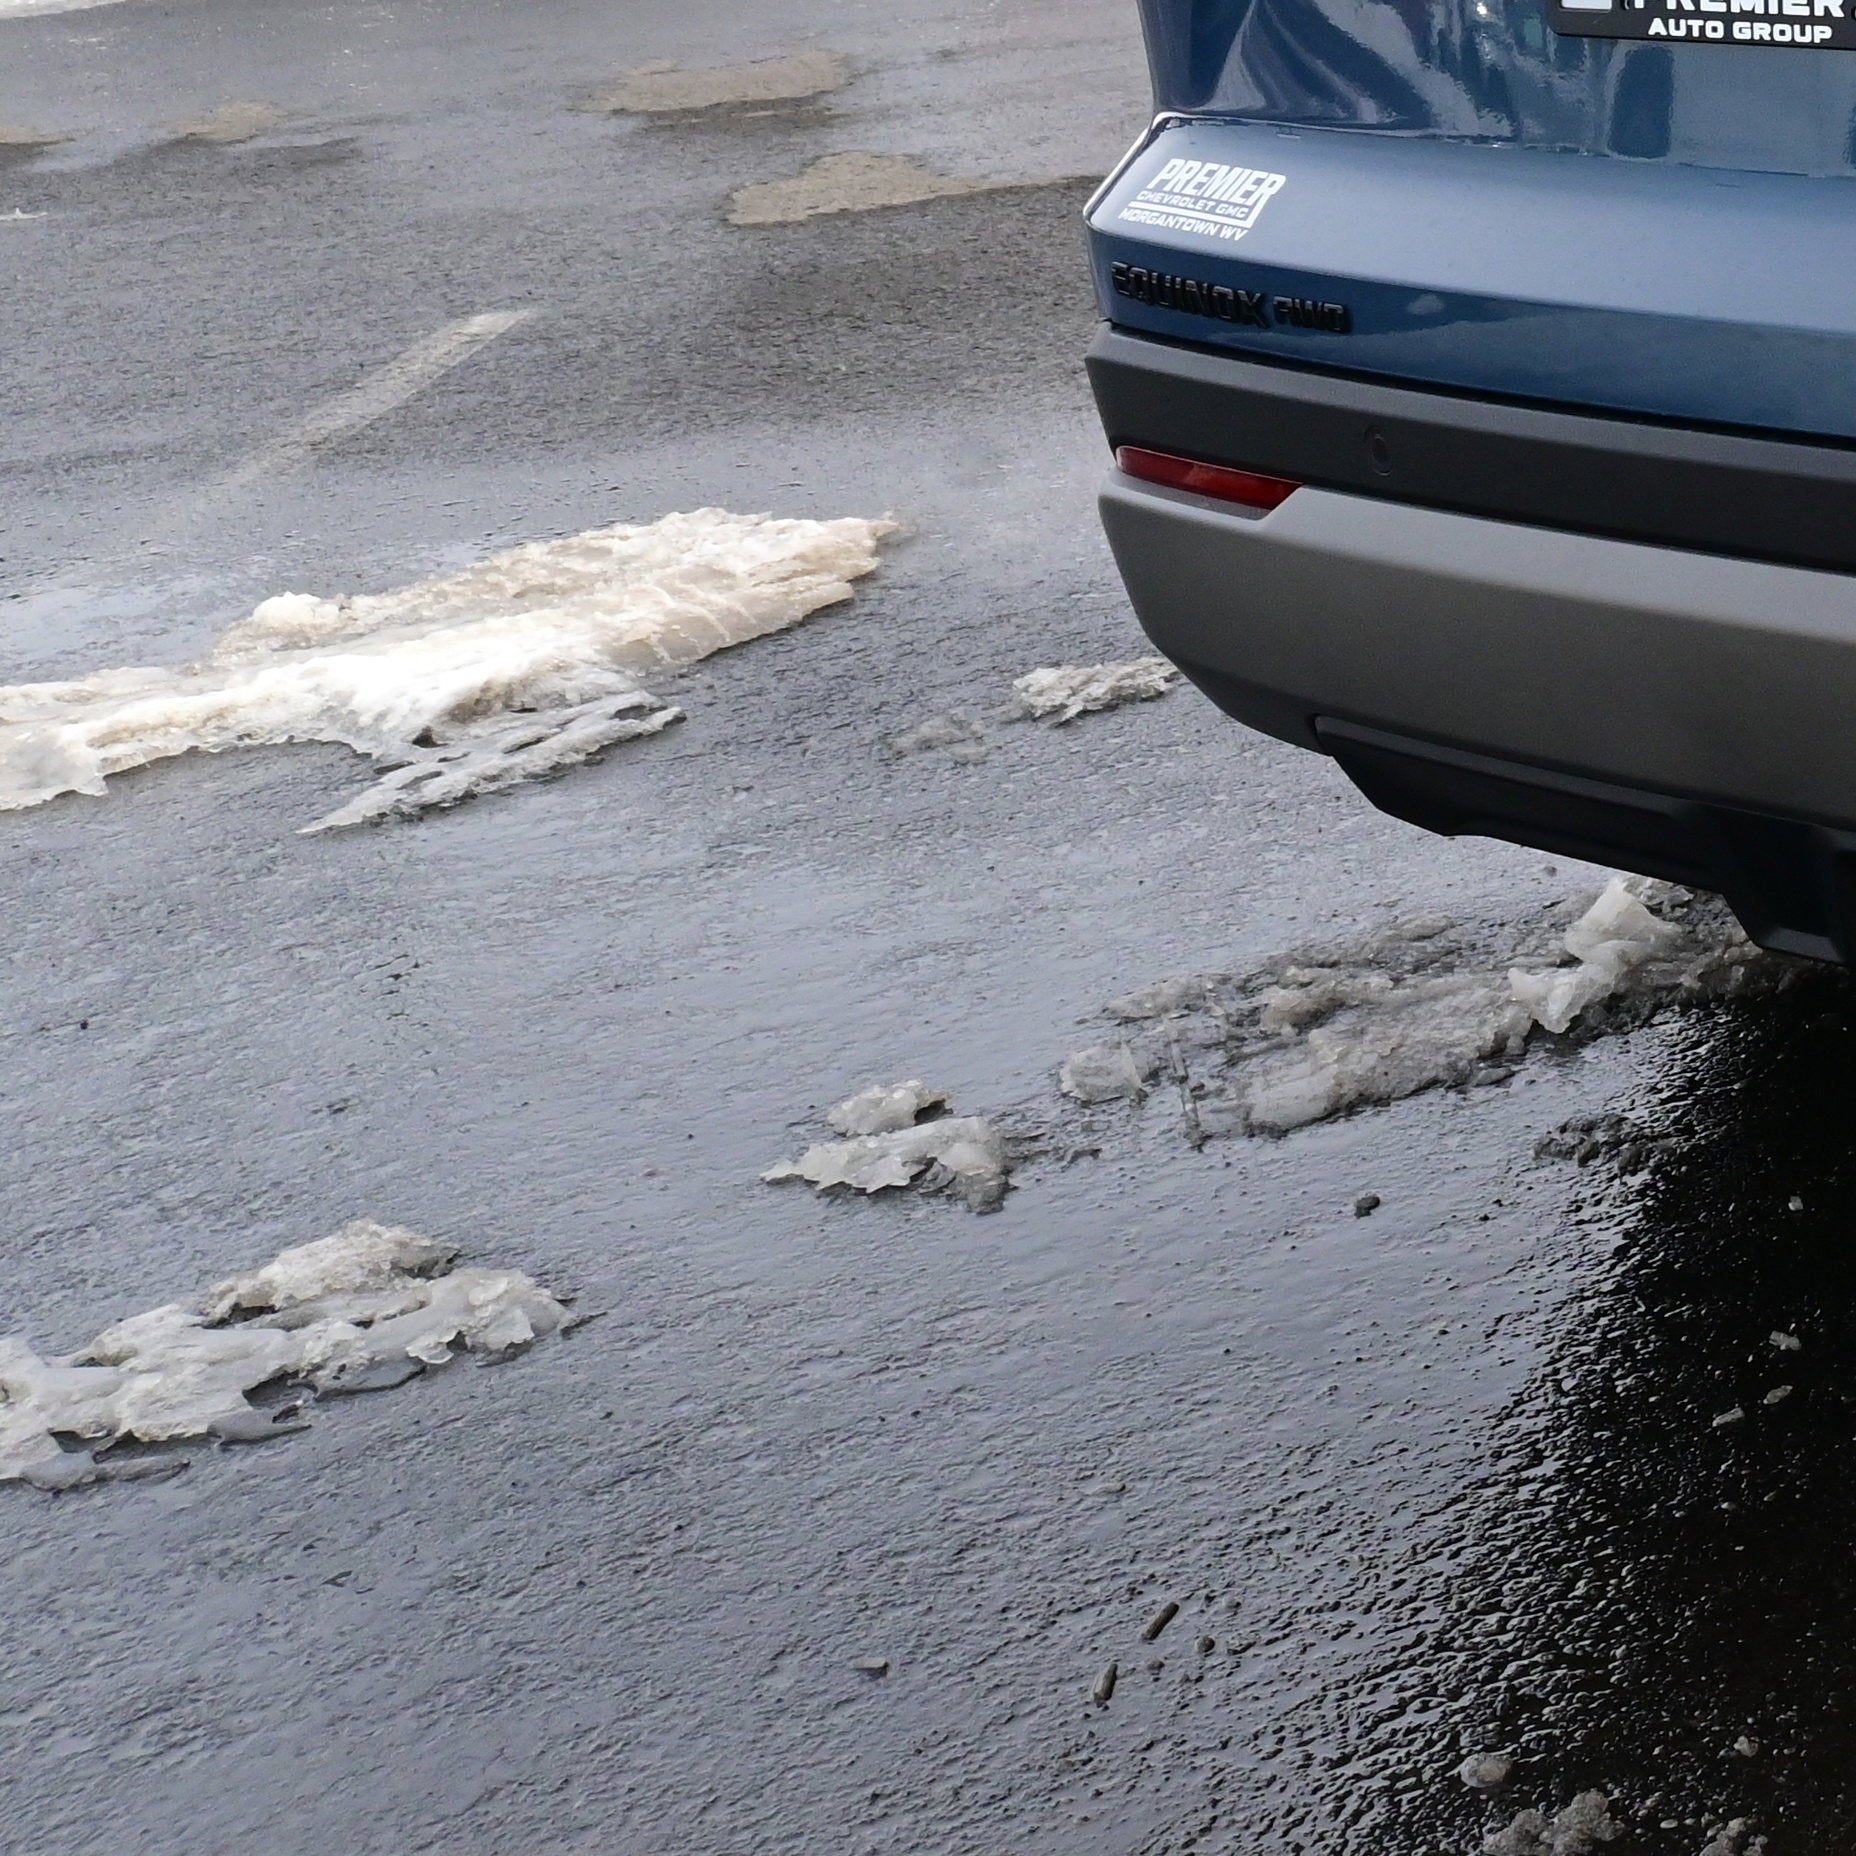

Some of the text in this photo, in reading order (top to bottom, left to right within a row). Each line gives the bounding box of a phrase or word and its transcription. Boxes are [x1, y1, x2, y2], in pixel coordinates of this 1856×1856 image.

[1648, 16, 1833, 44] AUTO GROUP
[1146, 158, 1287, 208] PREMIER
[1136, 190, 1250, 219] CHEVROLET GMC
[1118, 207, 1250, 242] MORGANTOWN WV
[1111, 261, 1352, 332] EQUINOX AWD
